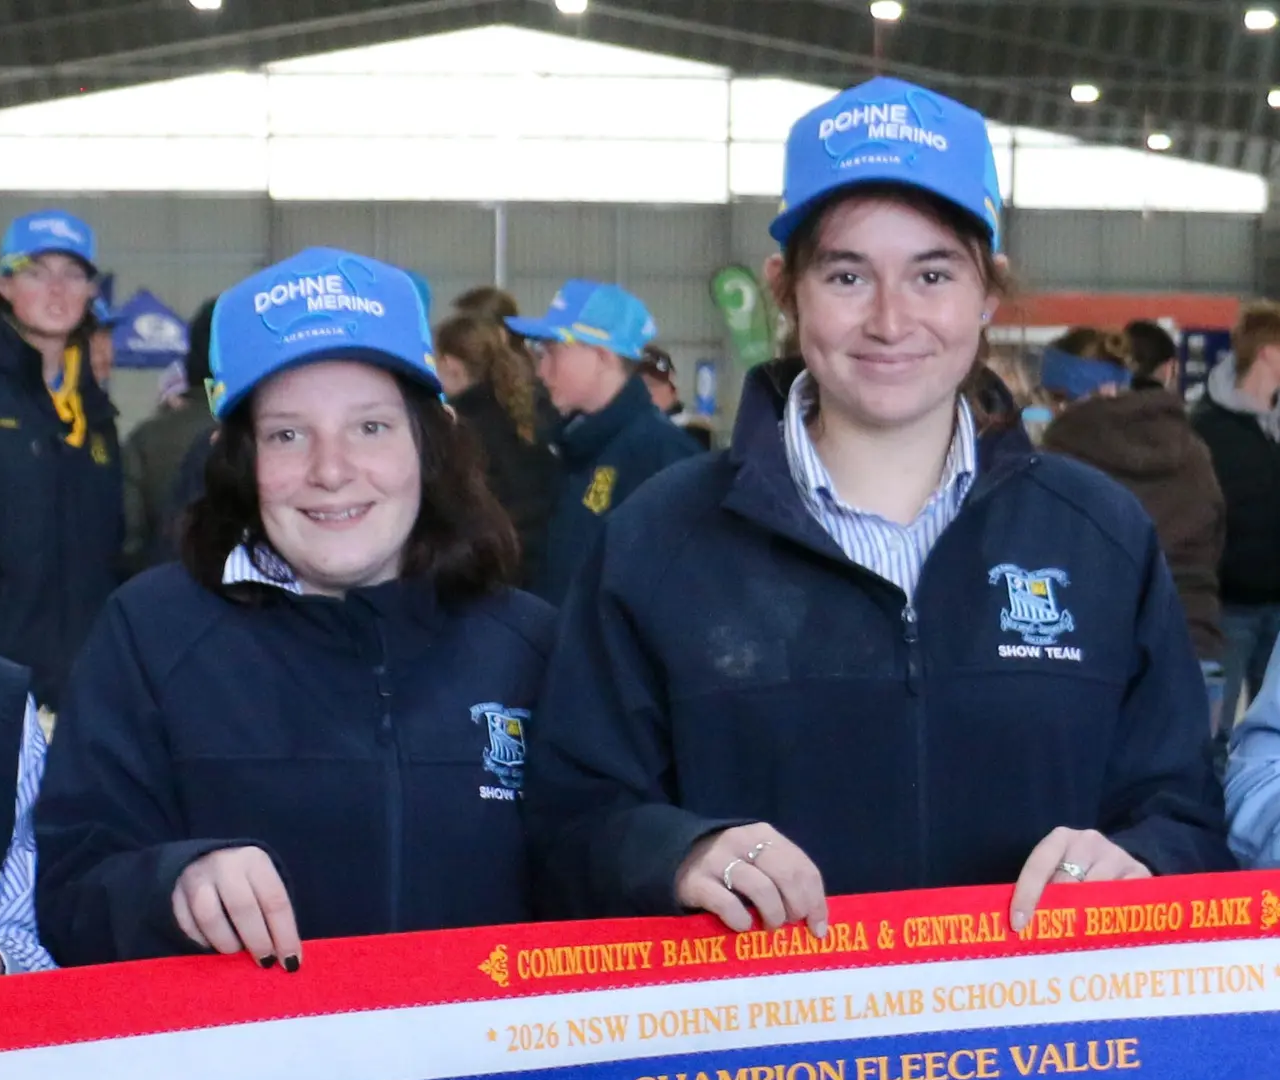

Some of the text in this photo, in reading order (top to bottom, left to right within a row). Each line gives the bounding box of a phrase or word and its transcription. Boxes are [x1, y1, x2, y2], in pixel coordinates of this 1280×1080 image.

[819, 103, 908, 139] DOHNE
[868, 123, 948, 152] MERINO
[254, 274, 344, 314] DOHNE
[307, 294, 385, 317] MERINO
[998, 644, 1082, 661] SHOW TEAM
[479, 785, 515, 800] SHOW
[516, 941, 654, 980] COMMUNITY
[662, 935, 728, 968] BANK
[877, 919, 895, 950] &
[903, 912, 1006, 948] CENTRAL
[1084, 902, 1184, 937] BENDIGO
[1190, 896, 1253, 930] BANK
[506, 963, 1266, 1052] 2026 NSW DOHNE PRIME LAMB SCHOOLS COMPETITION
[1009, 1037, 1141, 1076] VALUE
